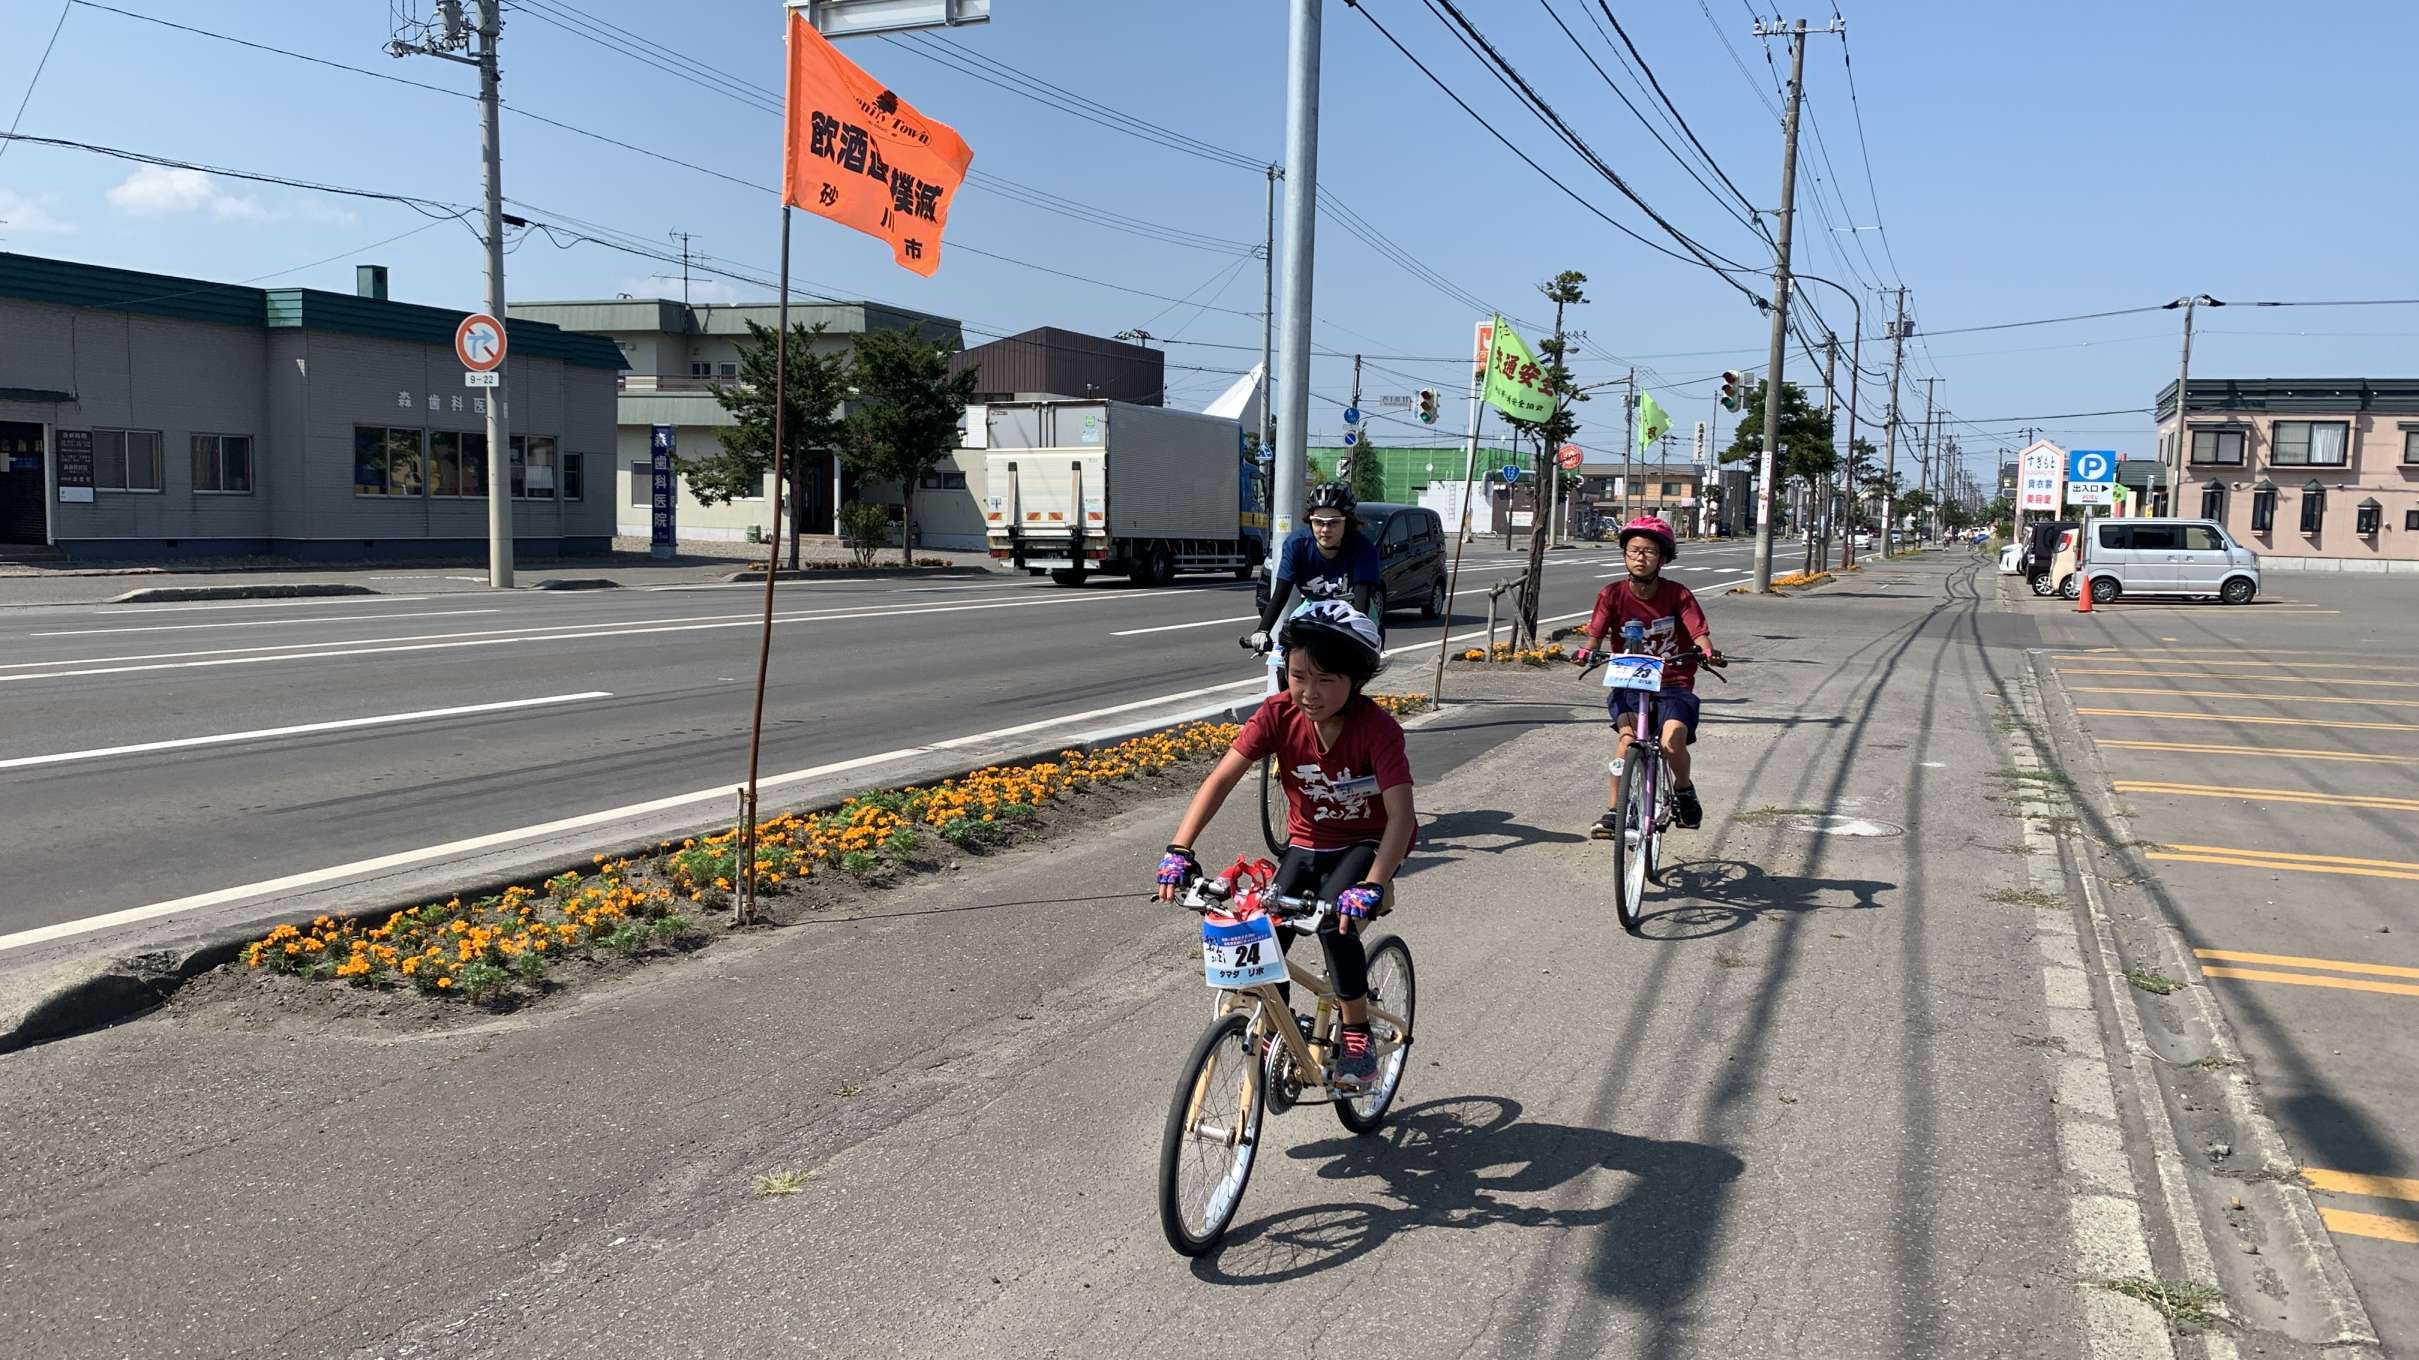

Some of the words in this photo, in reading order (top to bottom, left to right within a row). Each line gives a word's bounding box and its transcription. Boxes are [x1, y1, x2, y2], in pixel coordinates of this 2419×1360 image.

[891, 117, 929, 145] Town
[470, 375, 494, 384] 9-22
[398, 391, 508, 419] 森歯科医
[1507, 470, 1516, 479] 12
[2084, 457, 2102, 477] P
[654, 432, 668, 528] 森歯科医院
[2072, 484, 2099, 493] 出入口
[1632, 667, 1652, 679] 23
[1313, 804, 1372, 822] 2021
[1235, 942, 1260, 968] 24
[1219, 970, 1240, 979] タマダ
[1248, 967, 1265, 977] リホ
